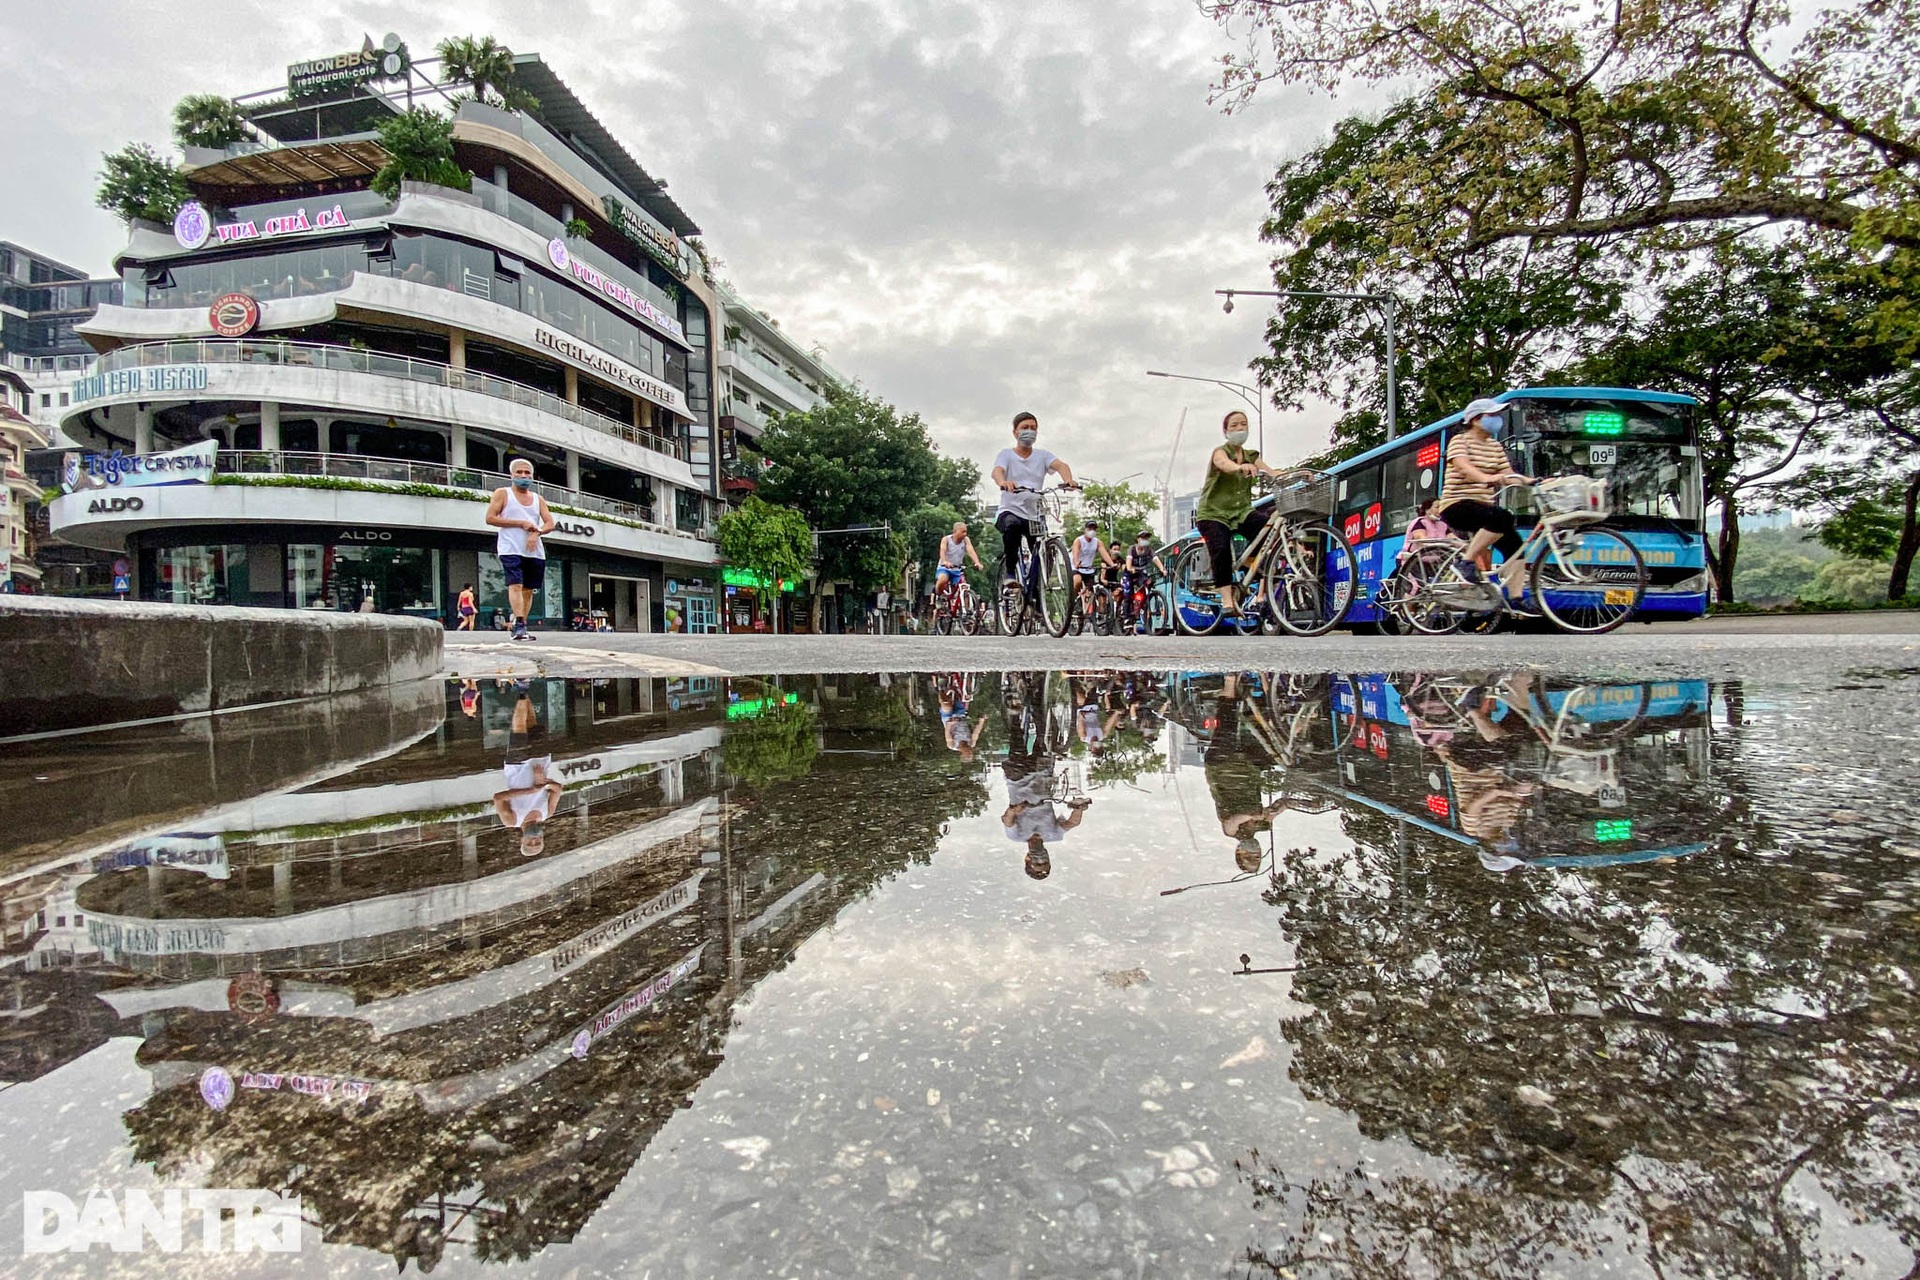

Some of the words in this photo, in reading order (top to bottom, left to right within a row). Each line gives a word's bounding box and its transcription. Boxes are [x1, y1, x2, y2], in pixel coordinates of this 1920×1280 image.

[289, 59, 334, 77] AVALON
[216, 221, 260, 242] VUA
[265, 208, 312, 235] CHẢ
[316, 204, 349, 228] CÁ
[621, 206, 656, 239] AVALON
[570, 259, 602, 291] VUA
[212, 296, 254, 316] HIGHLANDS
[217, 321, 251, 335] COFFEE
[106, 369, 141, 395] 1930
[147, 366, 208, 391] BISTRO
[83, 449, 141, 486] Tiger
[144, 454, 213, 473] CRYSTAL
[88, 497, 144, 513] ALDO
[555, 521, 595, 537] ALDO
[1365, 511, 1380, 529] ON
[339, 531, 392, 541] ALDO
[1345, 521, 1360, 539] ON
